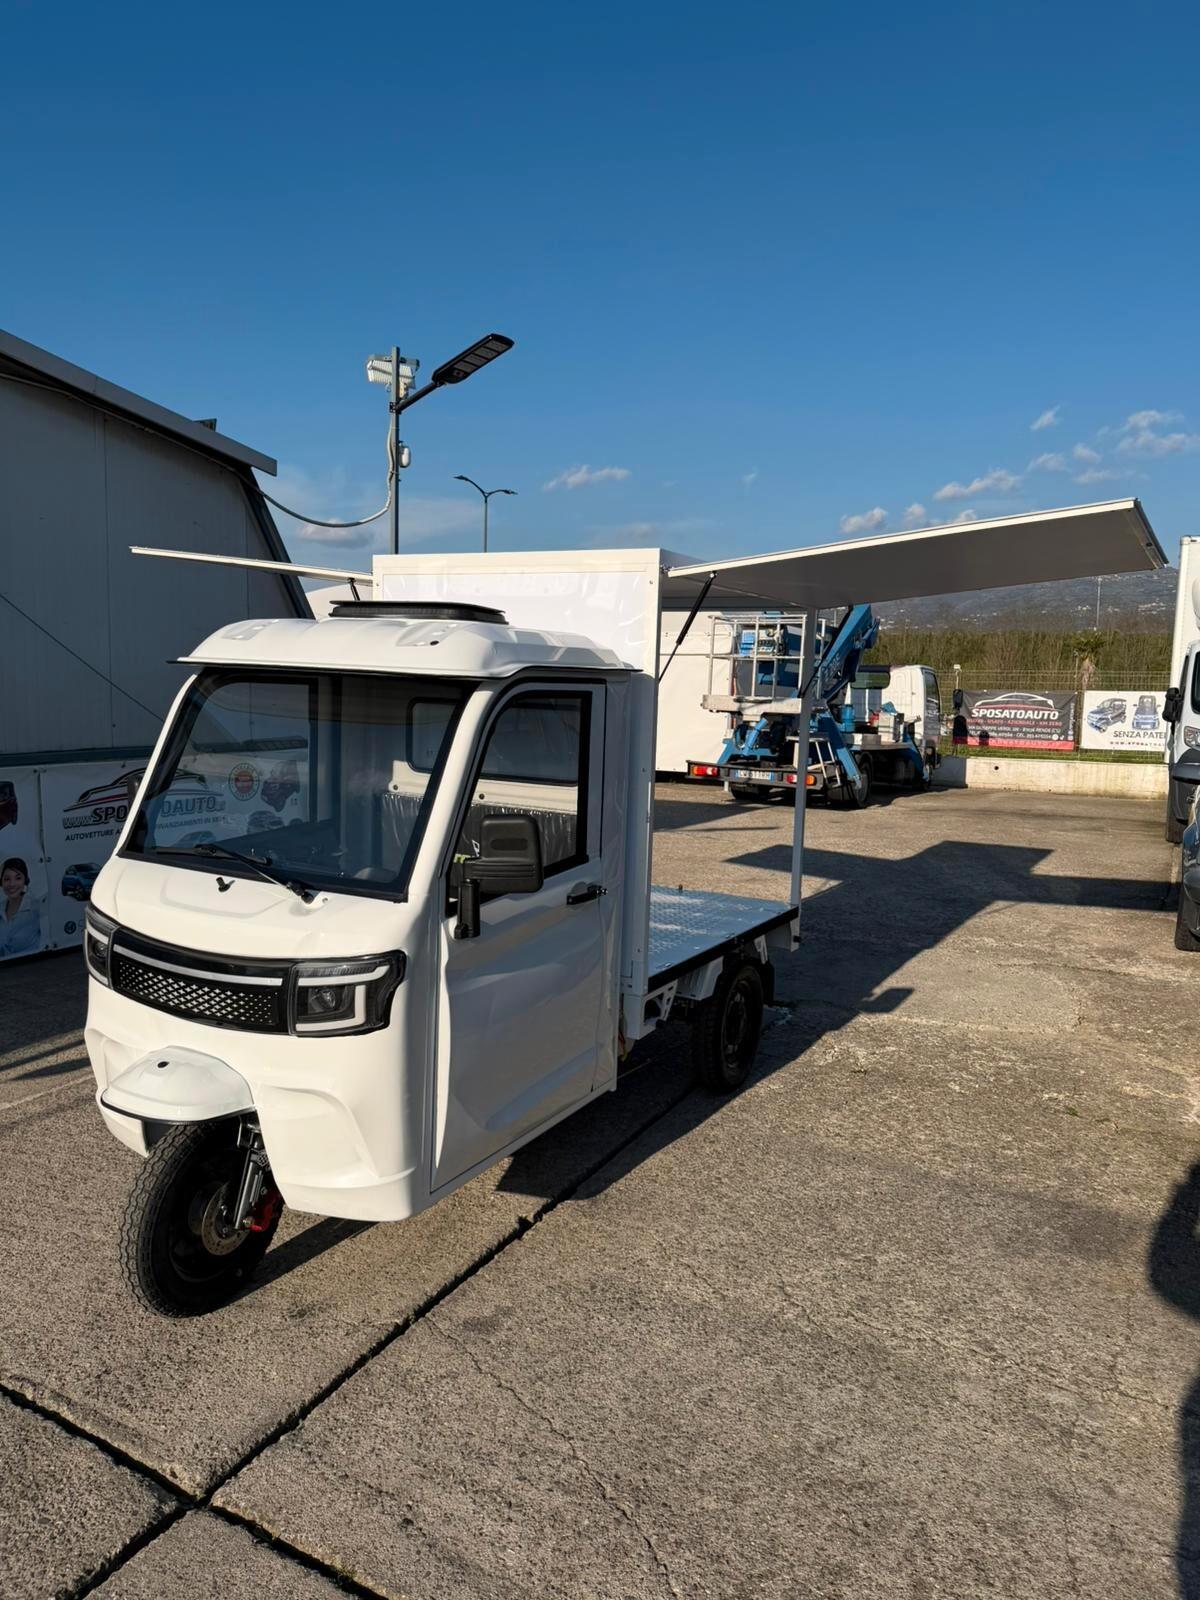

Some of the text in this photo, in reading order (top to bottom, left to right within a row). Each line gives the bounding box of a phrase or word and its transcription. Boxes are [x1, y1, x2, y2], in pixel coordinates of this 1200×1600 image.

[971, 708, 1059, 720] SPOSATOAUTO
[1113, 730, 1167, 739] SENZA PATE
[65, 829, 114, 841] AUTOVETTURE
